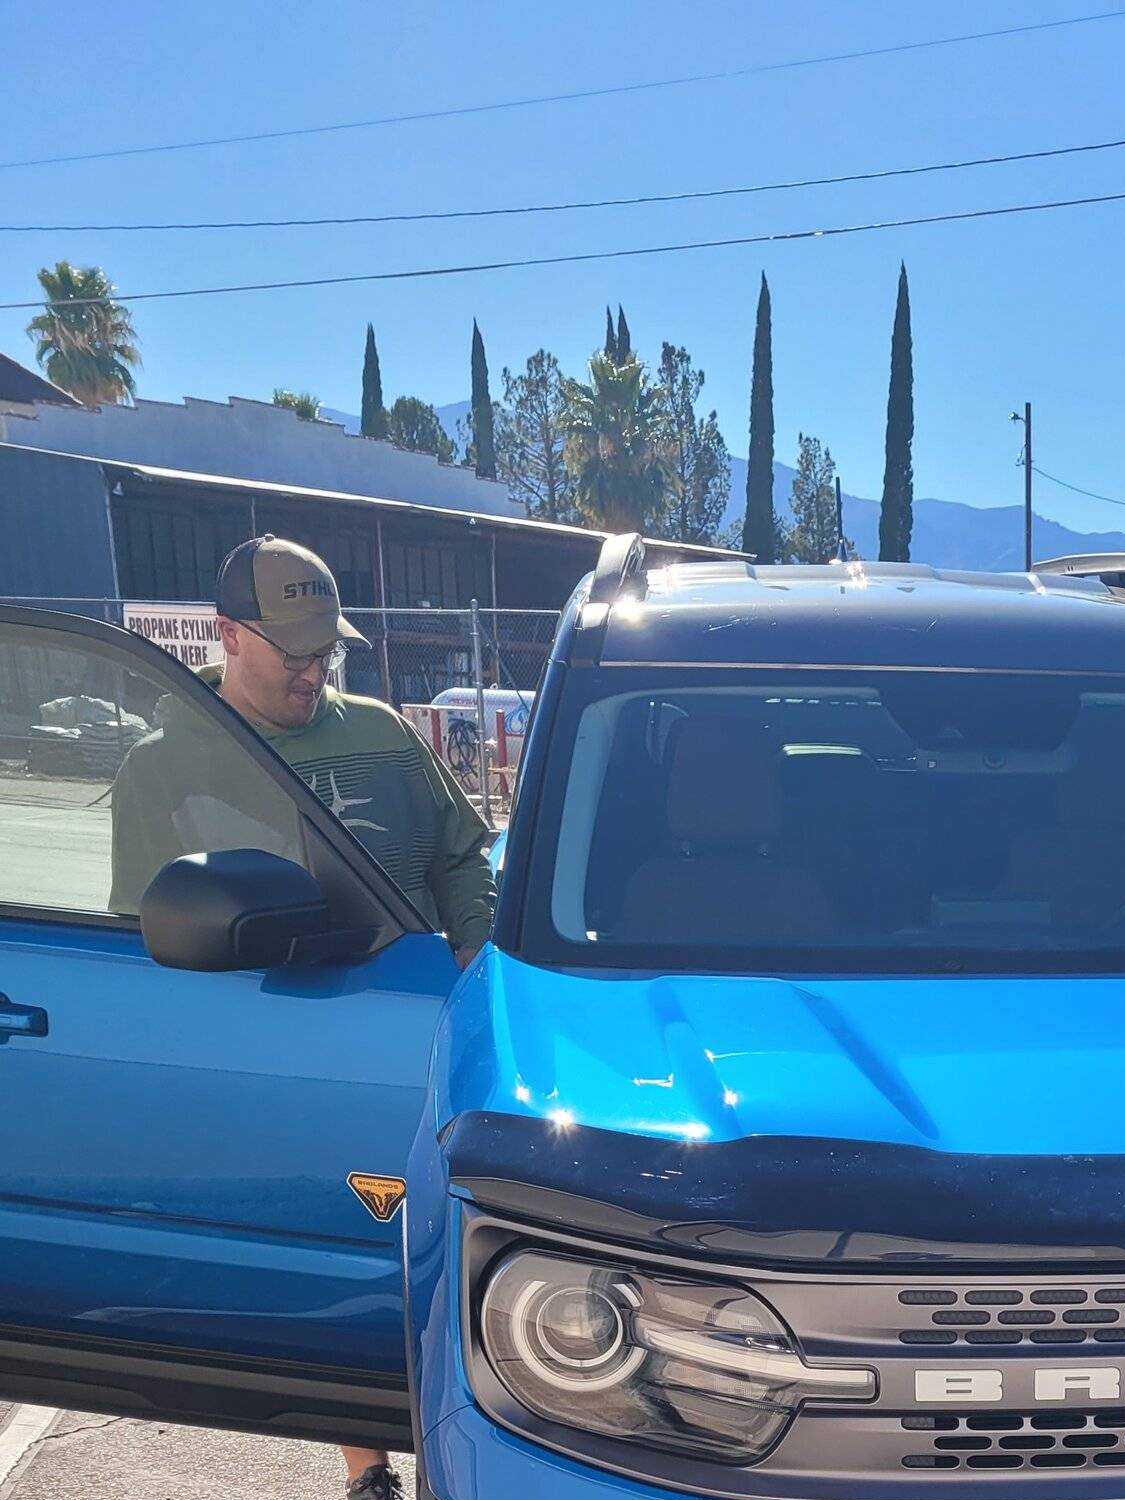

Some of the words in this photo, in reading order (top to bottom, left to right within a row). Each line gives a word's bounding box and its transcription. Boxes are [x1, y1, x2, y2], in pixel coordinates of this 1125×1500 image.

[128, 616, 180, 640] PROPANE
[181, 617, 222, 642] CYLIND
[180, 643, 209, 667] HERE
